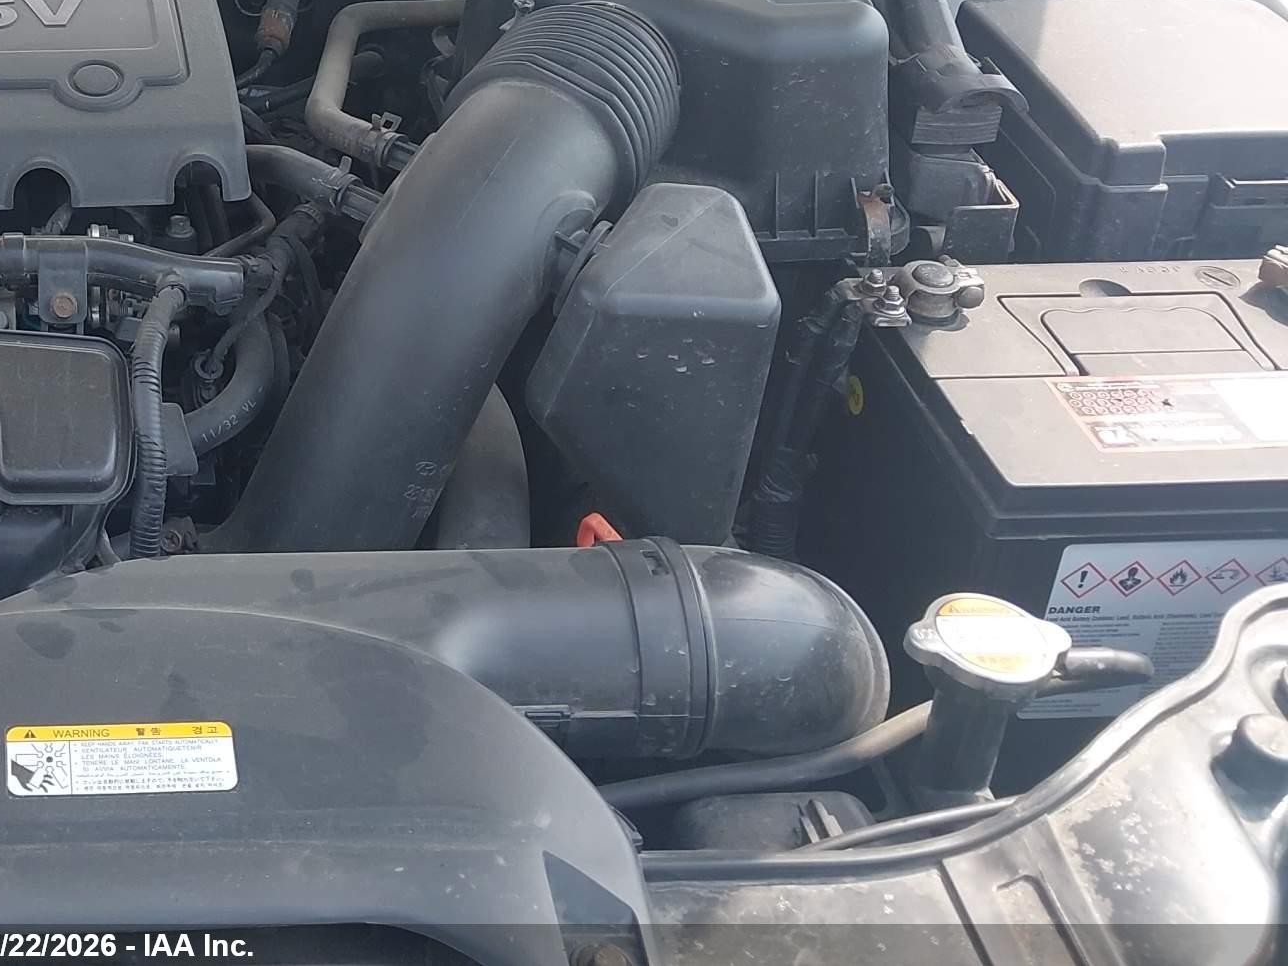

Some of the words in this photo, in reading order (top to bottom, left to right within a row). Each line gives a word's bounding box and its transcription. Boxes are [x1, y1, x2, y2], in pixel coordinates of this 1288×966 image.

[202, 414, 239, 443] 11/32
[1048, 605, 1101, 615] DANGER
[53, 729, 110, 739] WARNING
